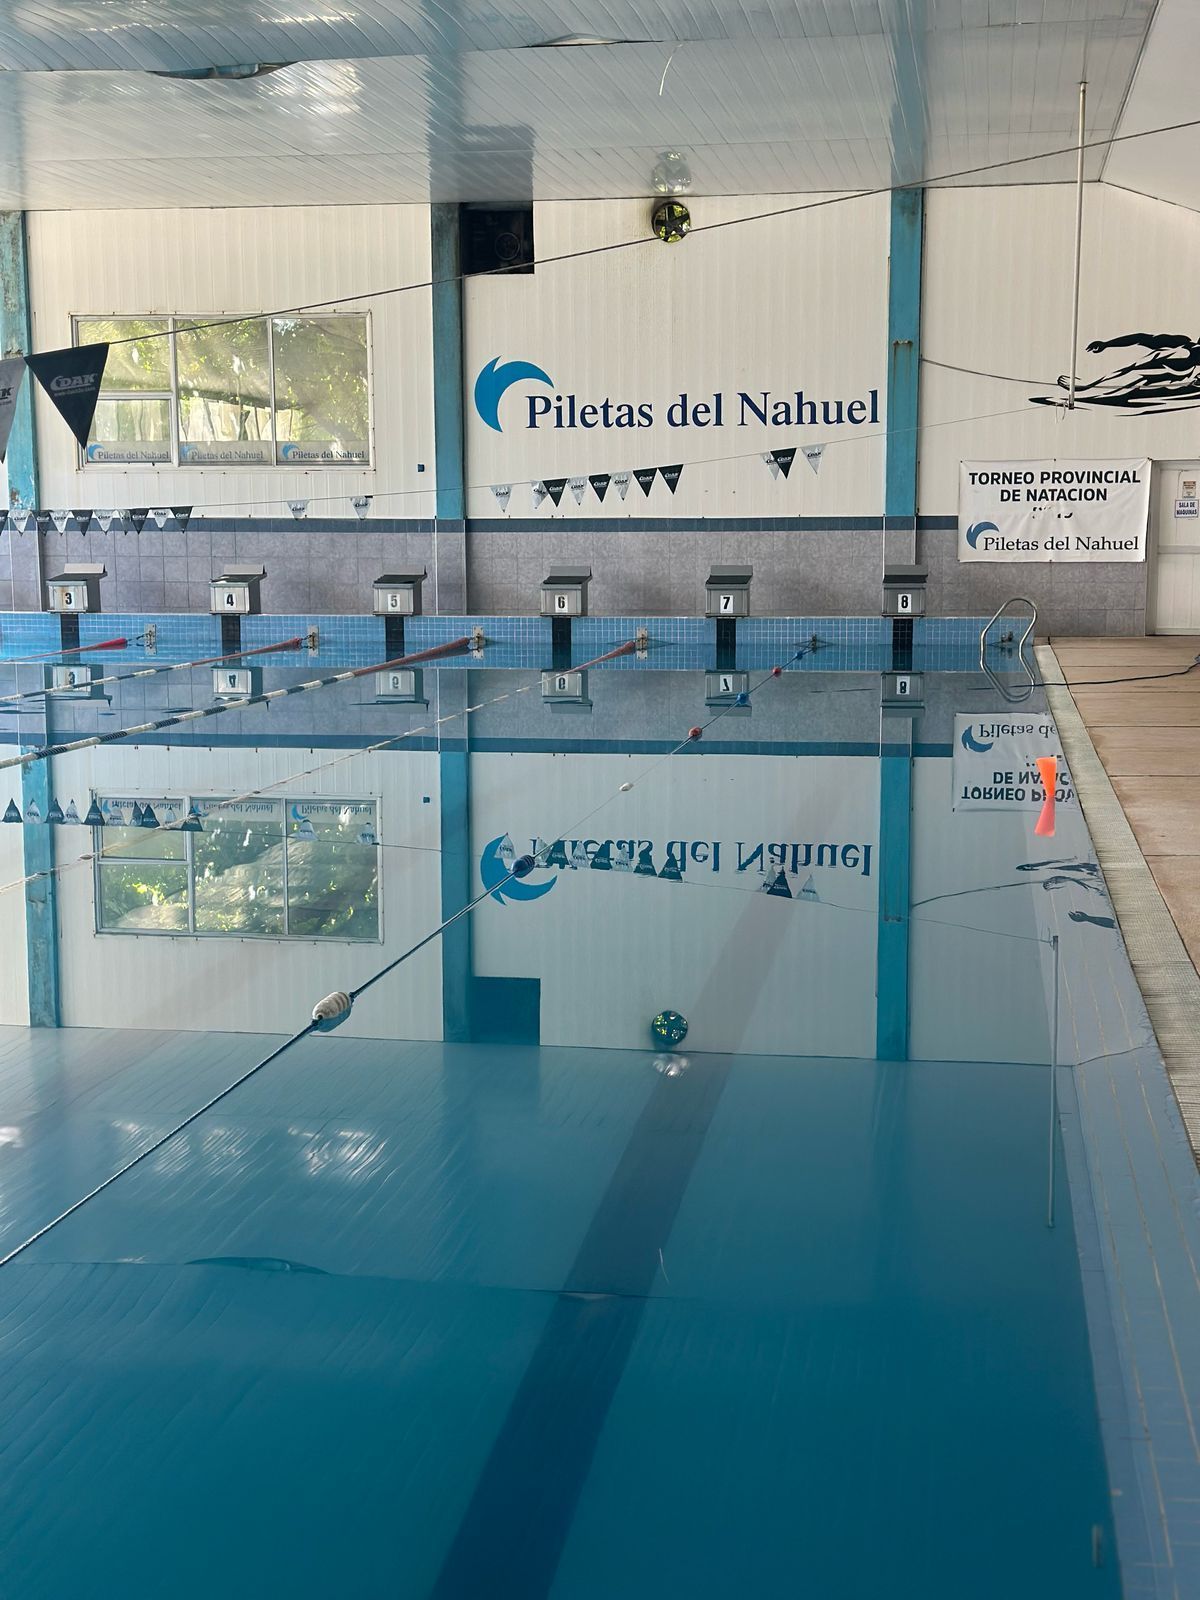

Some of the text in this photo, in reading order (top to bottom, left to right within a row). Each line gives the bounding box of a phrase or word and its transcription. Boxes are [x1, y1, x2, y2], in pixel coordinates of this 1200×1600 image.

[525, 388, 880, 429] Piletas del Nahuel
[97, 449, 170, 461] Piletas del Nahuel
[220, 450, 233, 461] del
[234, 449, 264, 461] Nahuel
[292, 449, 365, 460] Piletas del Nahuel
[968, 470, 1141, 485] TORNEO PROVINCIAL
[1000, 488, 1108, 502] DE NATACION
[983, 536, 1139, 552] Piletas del Nahuel
[65, 592, 73, 605] 3
[226, 593, 235, 607] 4
[390, 593, 398, 608] 5
[558, 595, 566, 609] 6
[722, 596, 731, 610] 7
[901, 595, 909, 609] 8
